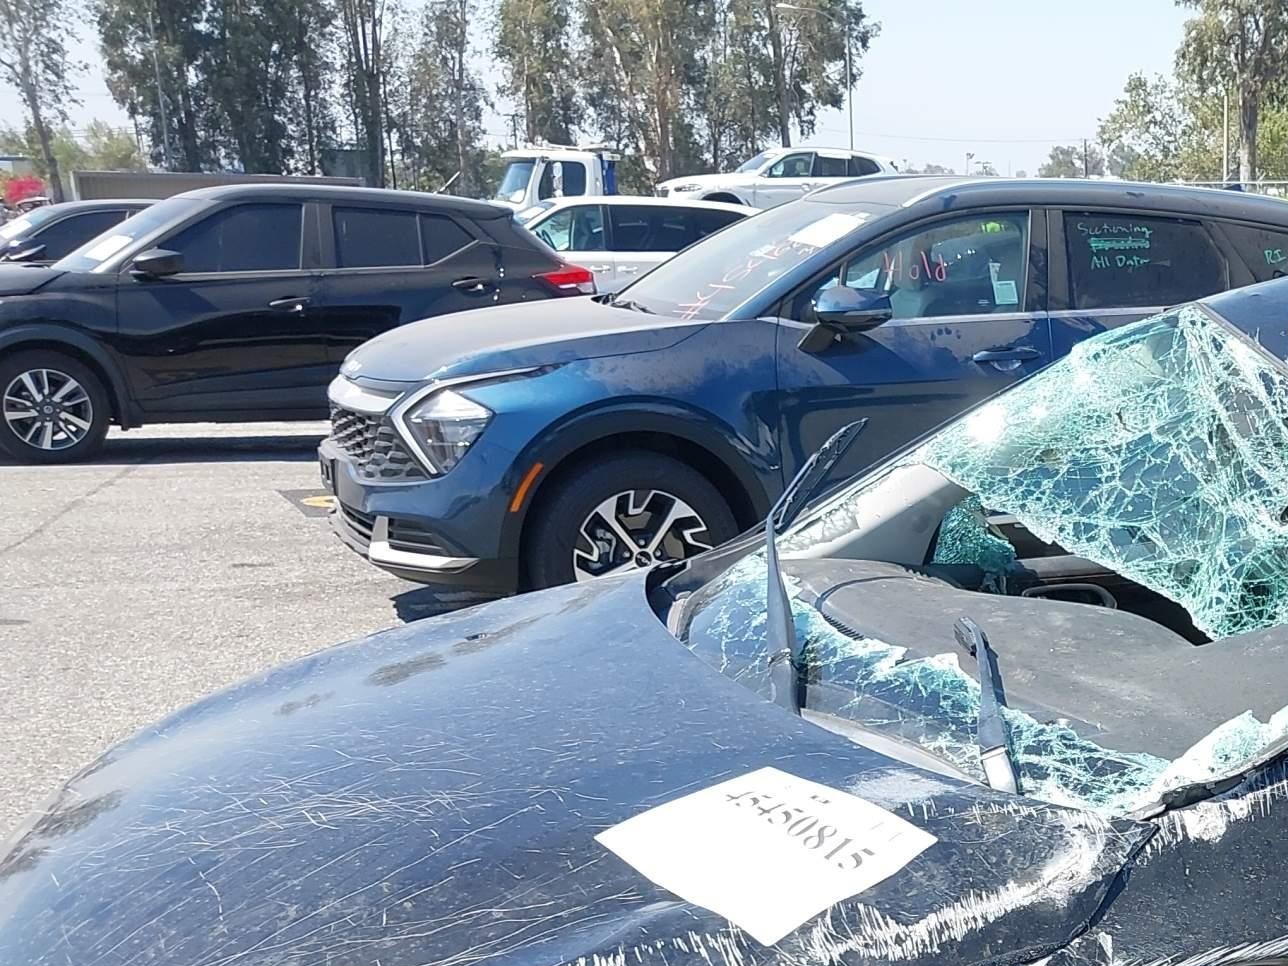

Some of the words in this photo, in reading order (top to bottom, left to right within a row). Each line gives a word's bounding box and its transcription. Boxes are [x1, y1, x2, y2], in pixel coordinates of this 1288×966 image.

[883, 250, 946, 282] Hold
[1090, 255, 1111, 270] All
[726, 791, 876, 870] 45450815
